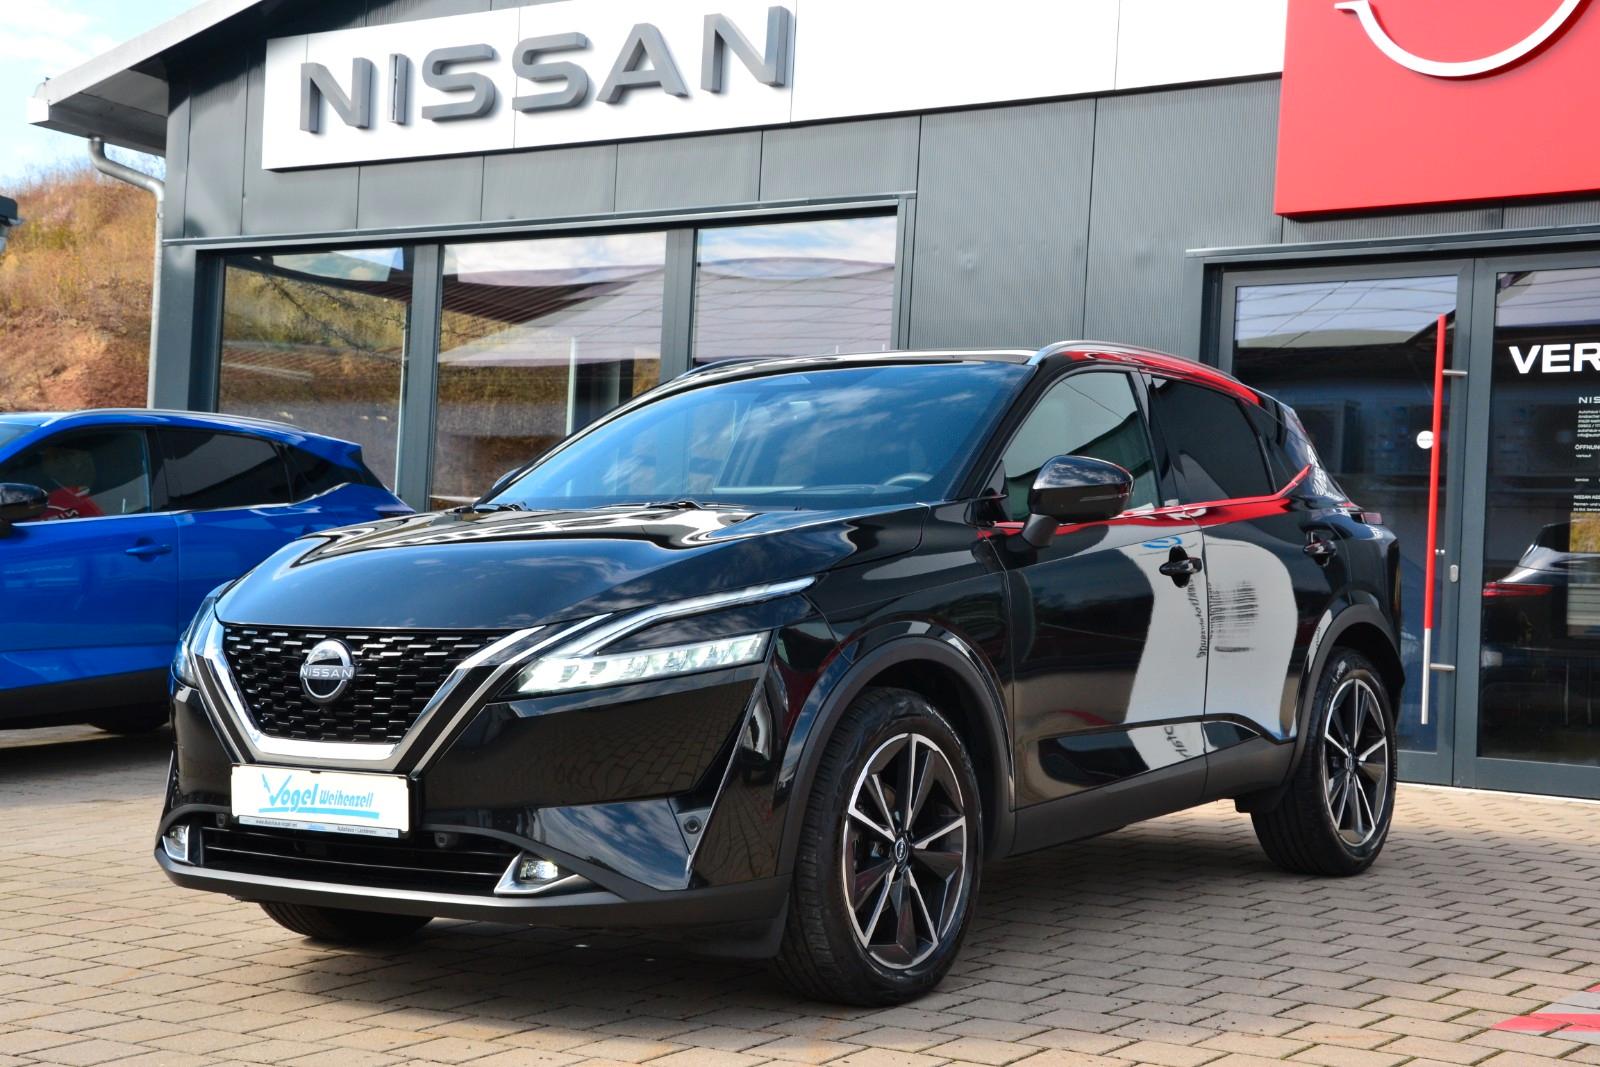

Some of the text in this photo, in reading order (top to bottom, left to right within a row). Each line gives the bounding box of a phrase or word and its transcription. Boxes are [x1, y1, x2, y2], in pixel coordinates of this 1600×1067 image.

[300, 5, 790, 134] NISSAN
[300, 668, 353, 678] NISSAN
[262, 774, 374, 812] Vogel Weihenzell
